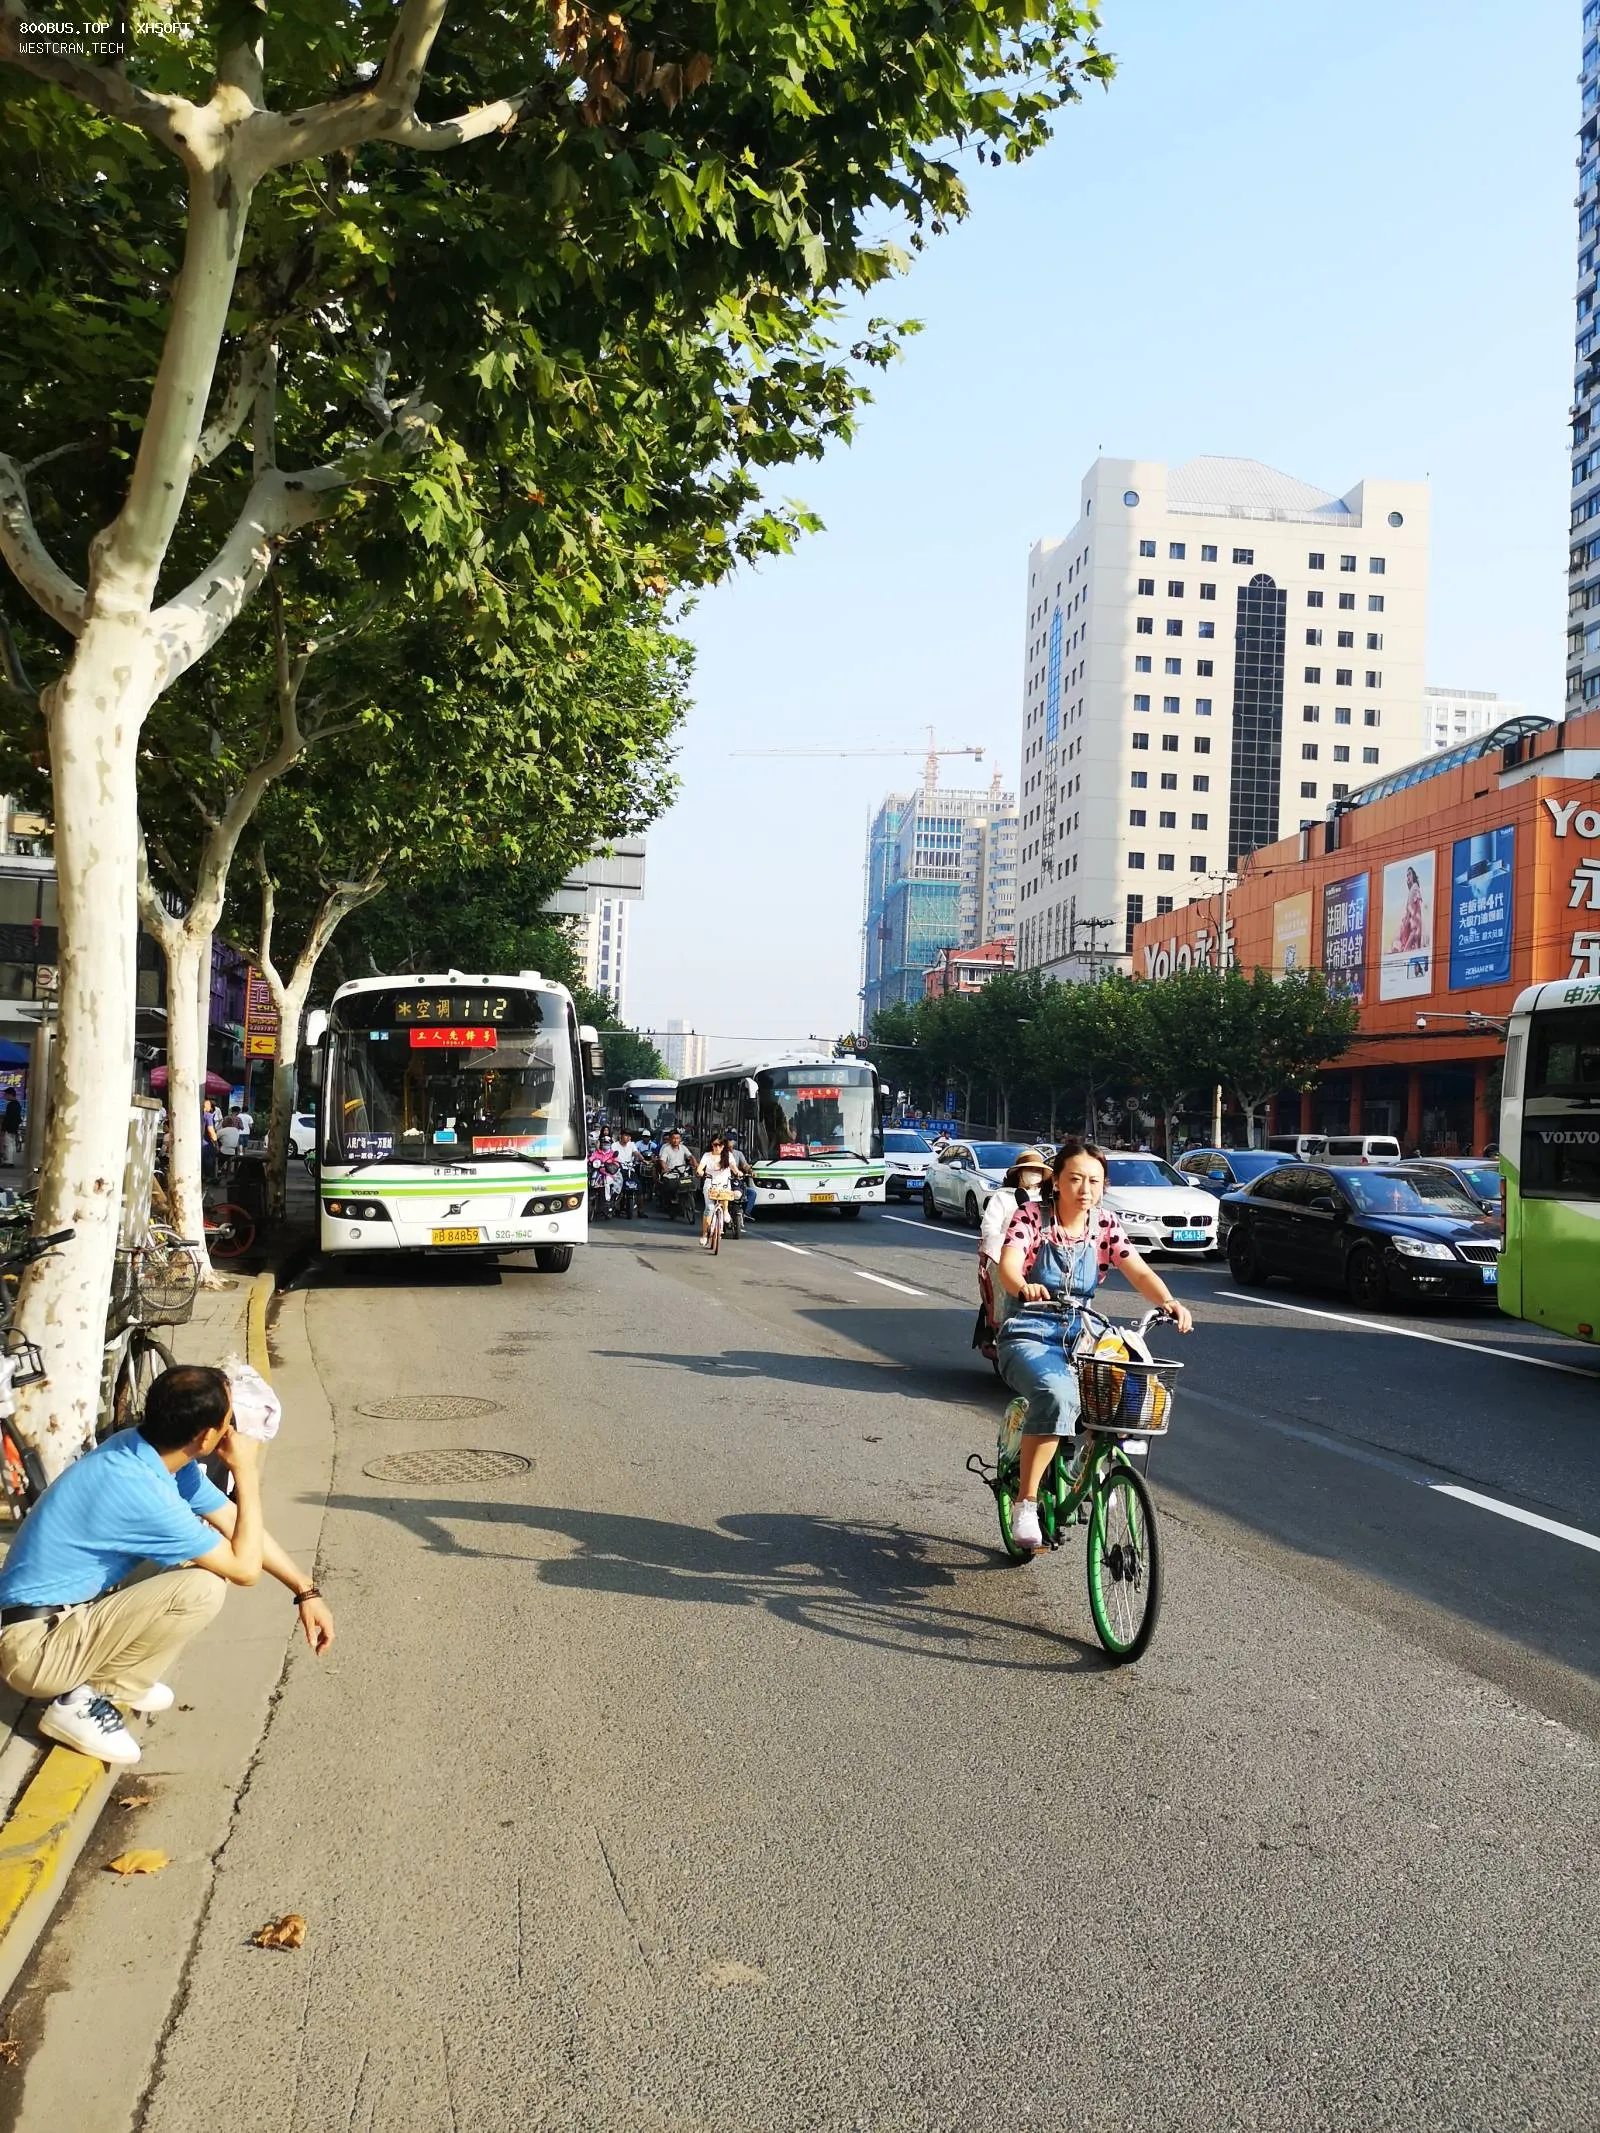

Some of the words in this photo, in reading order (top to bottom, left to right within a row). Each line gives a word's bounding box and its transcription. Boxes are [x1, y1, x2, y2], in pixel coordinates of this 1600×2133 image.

[1327, 898, 1364, 937] 法国队夺冠
[1326, 934, 1363, 970] 华帝退全款
[416, 999, 450, 1018] 空调
[464, 998, 507, 1020] 112
[416, 1029, 492, 1042] 工人先锋号
[1539, 1131, 1600, 1144] VOLVO
